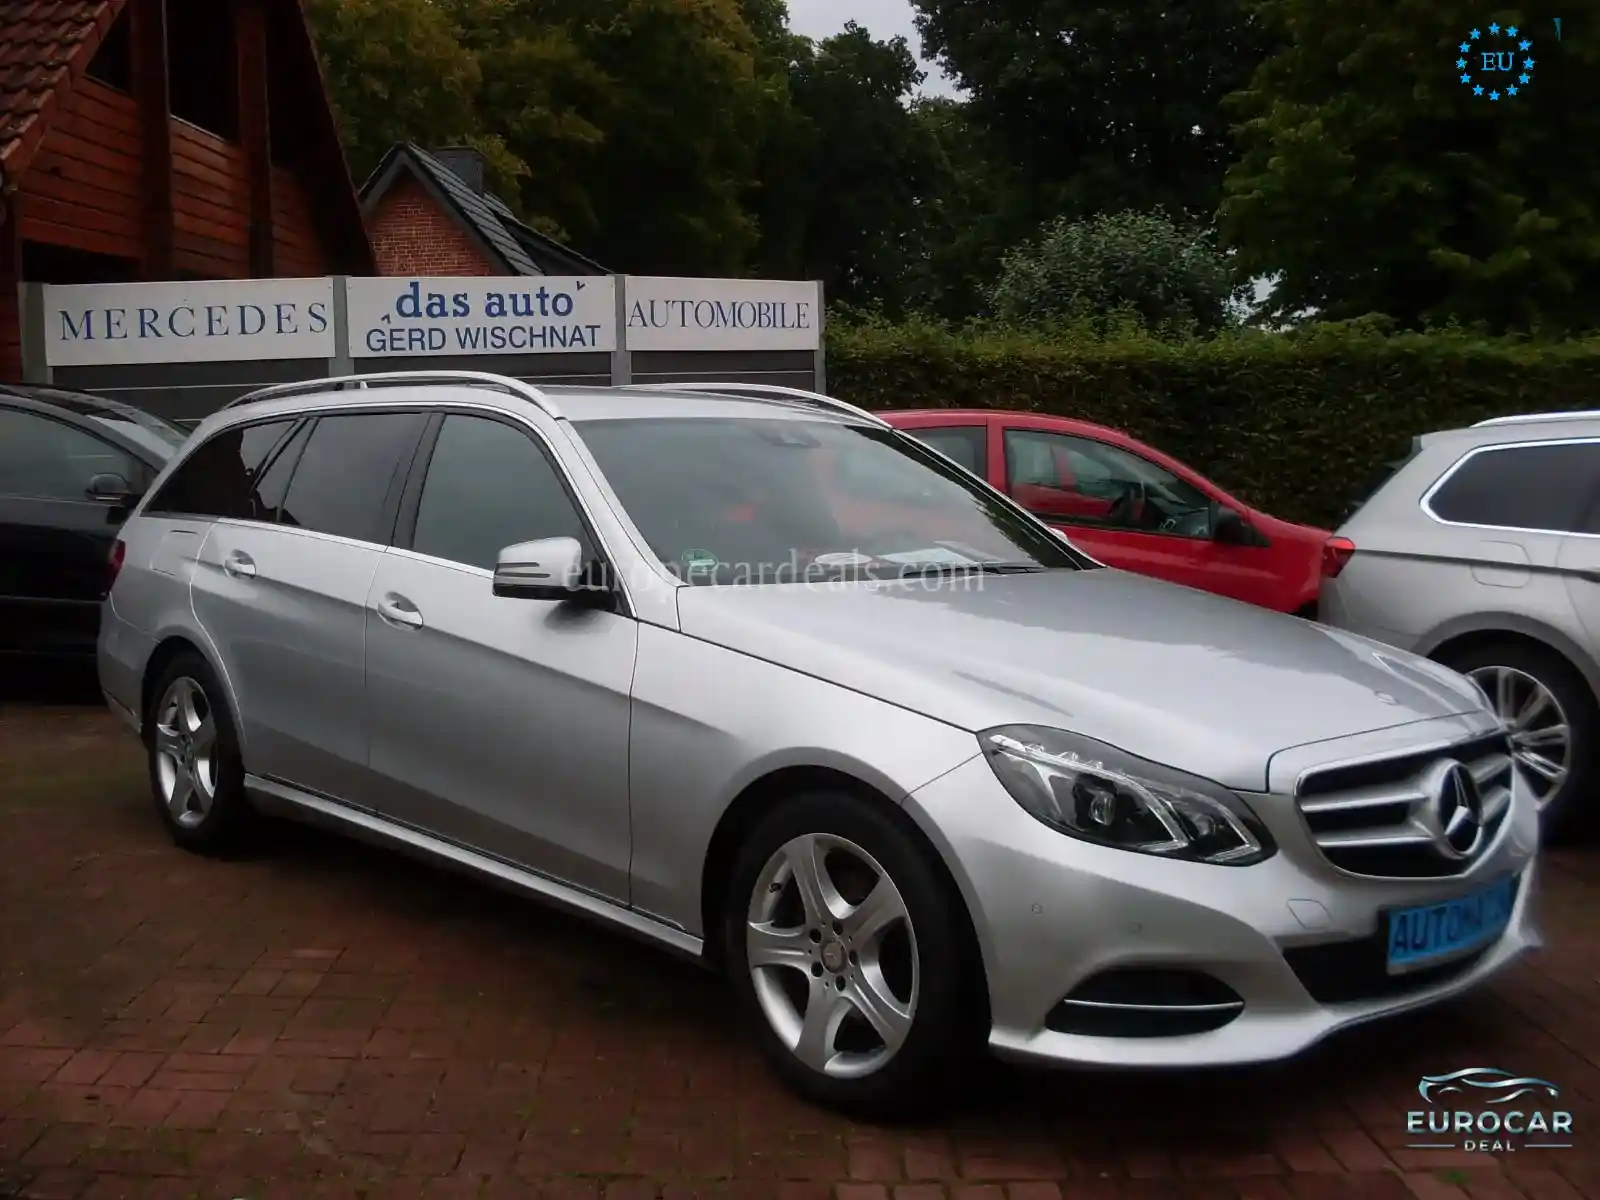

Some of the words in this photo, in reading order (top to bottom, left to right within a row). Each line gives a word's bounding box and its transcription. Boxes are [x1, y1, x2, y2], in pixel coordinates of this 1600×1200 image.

[396, 281, 470, 319] das
[484, 284, 575, 318] auto
[627, 299, 810, 329] AUTOMOBILE
[58, 302, 328, 341] MERCEDES
[366, 327, 447, 352] GERD
[456, 325, 601, 350] WISCHNAT
